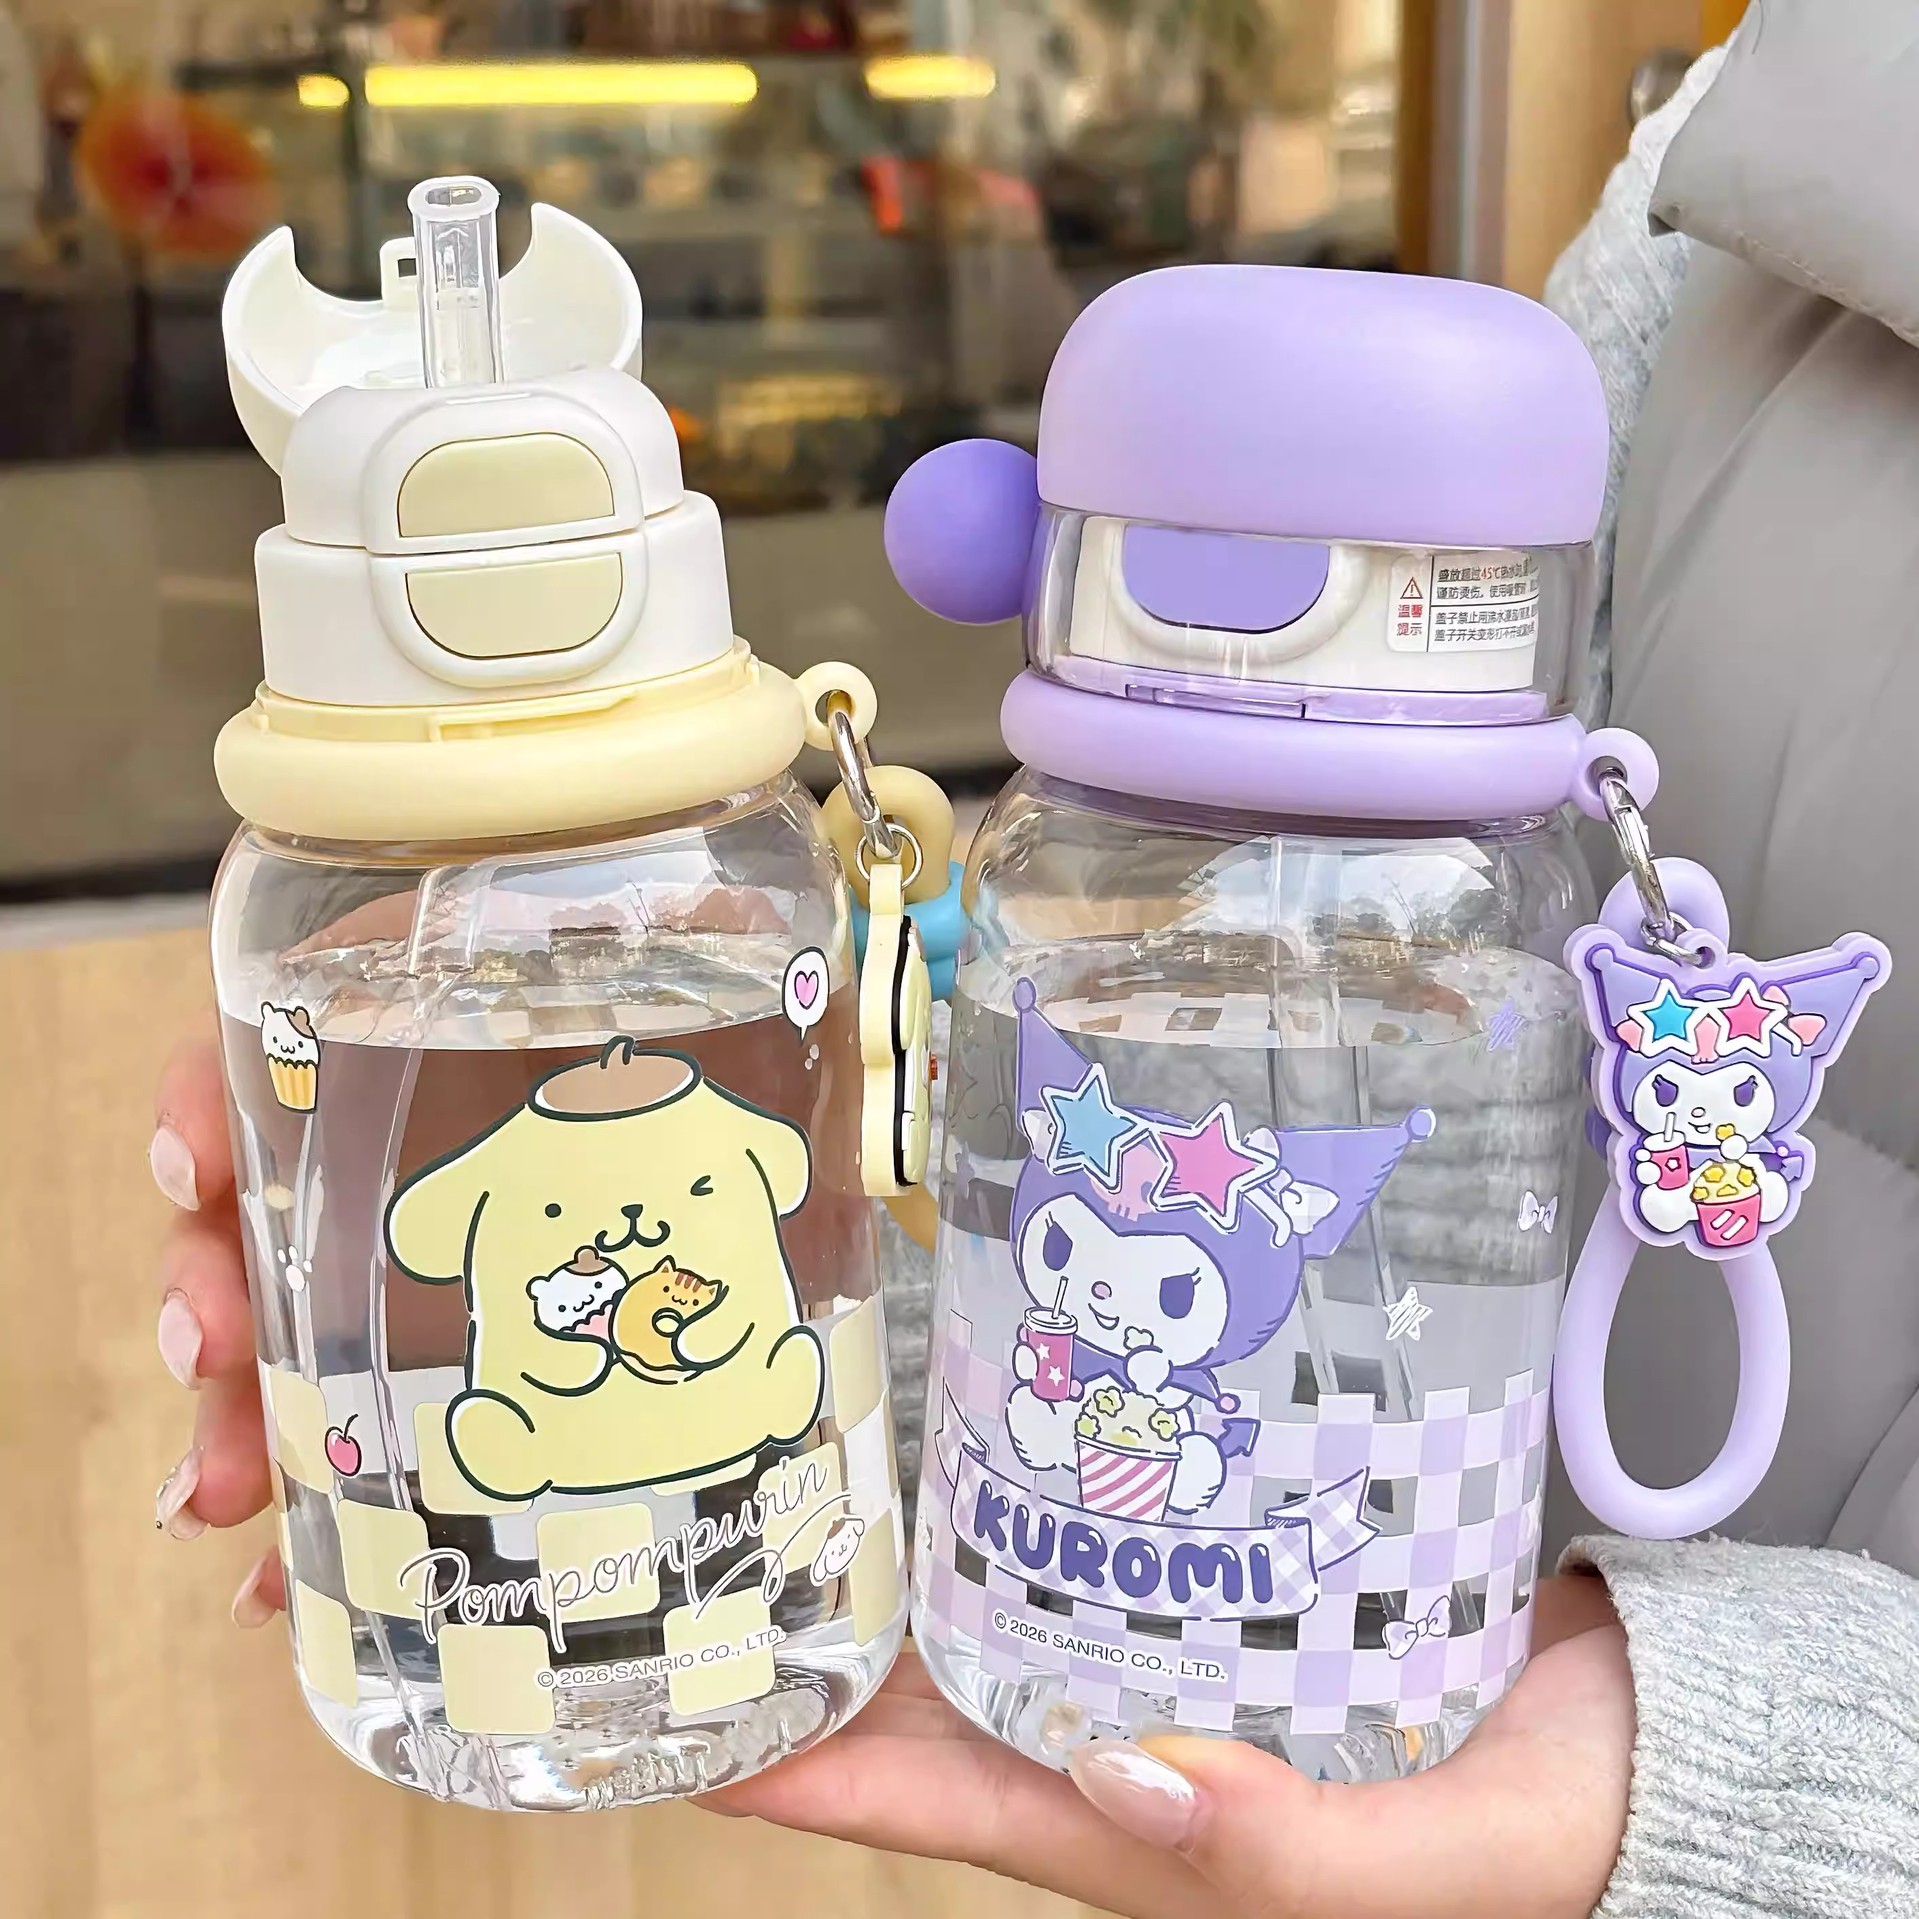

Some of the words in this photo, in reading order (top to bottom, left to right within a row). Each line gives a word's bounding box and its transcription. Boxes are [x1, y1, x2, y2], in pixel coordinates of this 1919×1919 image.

[1396, 623, 1422, 636] 提示
[399, 1457, 830, 1653] Pompompurin
[974, 1479, 1274, 1604] KUROMI
[558, 1669, 608, 1686] 2026
[614, 1654, 694, 1680] SANRIO
[700, 1644, 742, 1663] CO.,
[746, 1629, 785, 1650] LTD.
[1010, 1620, 1048, 1643] 2026
[1053, 1634, 1125, 1664] SANRIO
[1131, 1653, 1173, 1675] CO.,
[1181, 1660, 1225, 1680] LTD.
